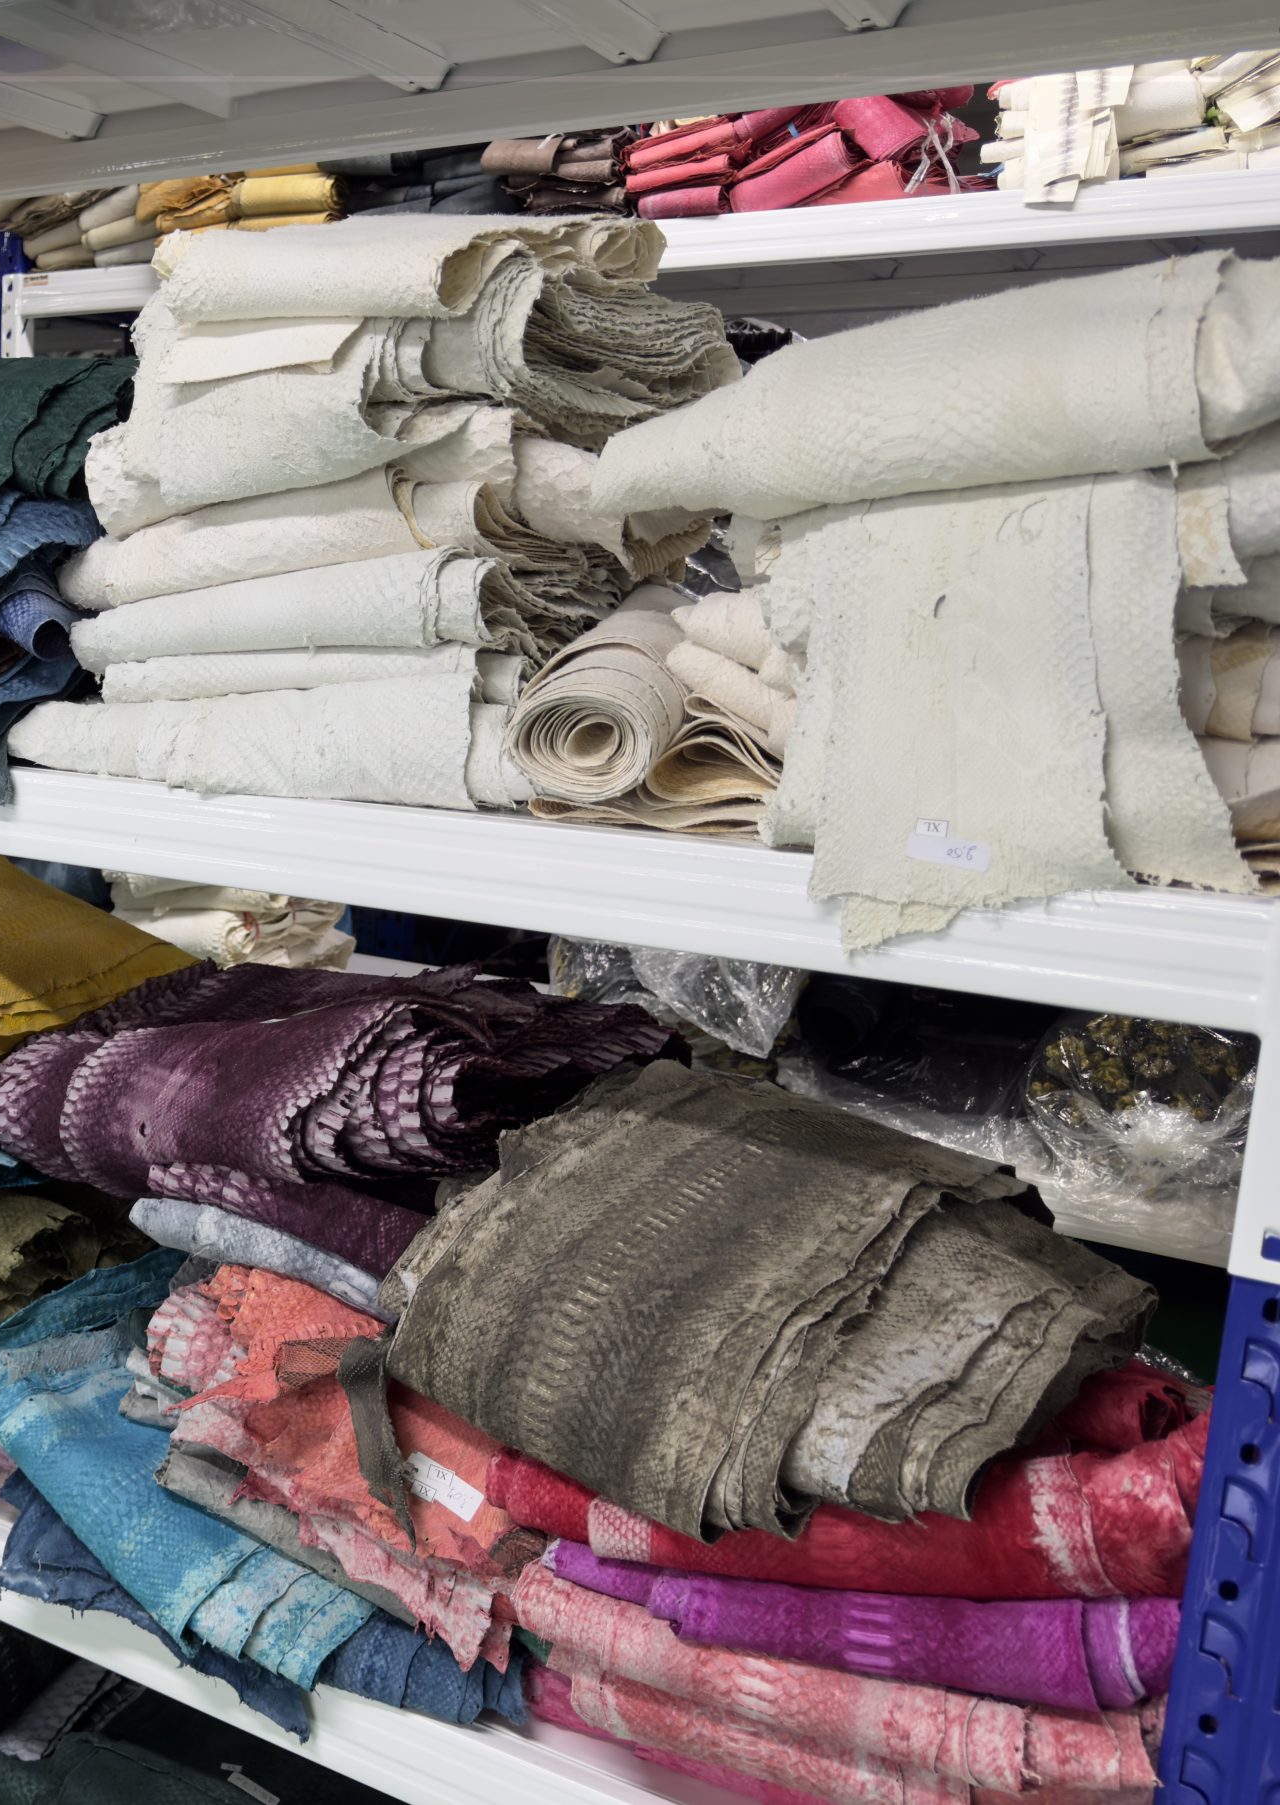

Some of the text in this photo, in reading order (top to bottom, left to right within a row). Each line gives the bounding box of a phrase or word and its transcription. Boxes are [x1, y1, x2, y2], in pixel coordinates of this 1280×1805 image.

[923, 821, 941, 832] XL
[435, 1468, 448, 1481] XL
[419, 1485, 431, 1497] XL
